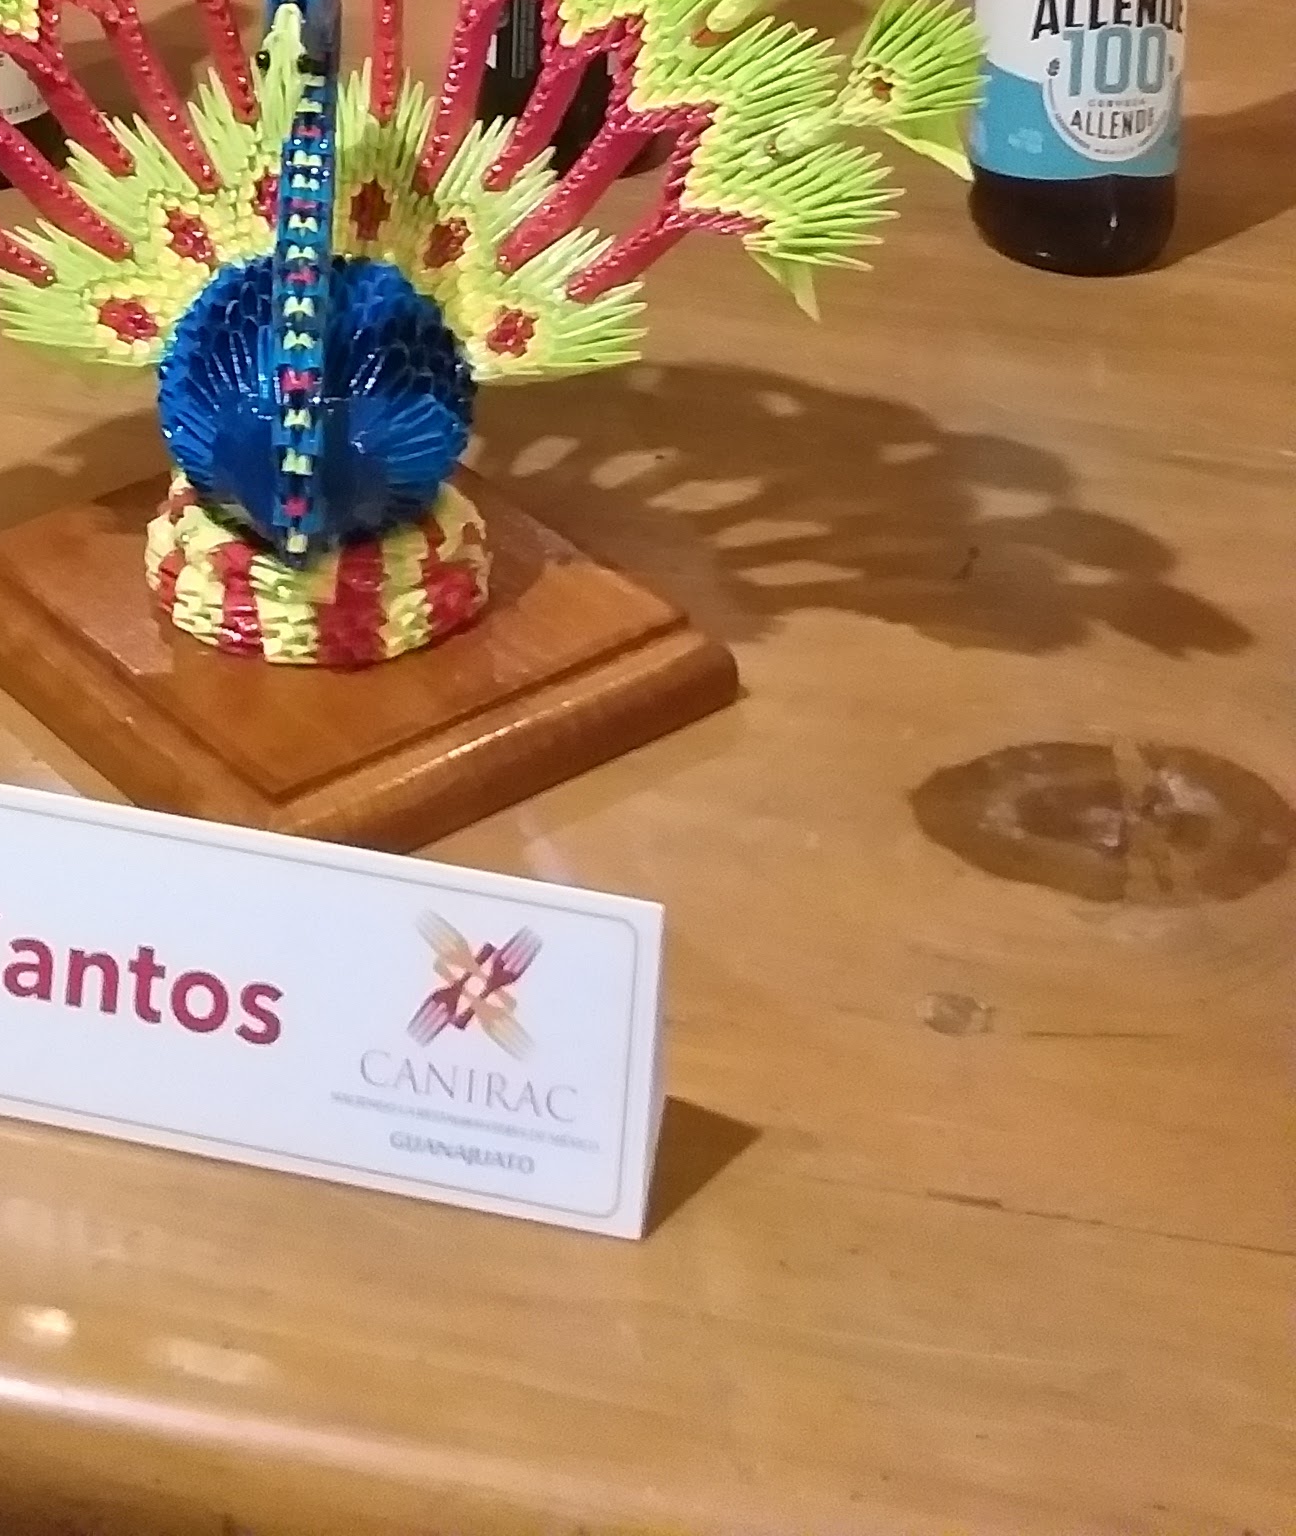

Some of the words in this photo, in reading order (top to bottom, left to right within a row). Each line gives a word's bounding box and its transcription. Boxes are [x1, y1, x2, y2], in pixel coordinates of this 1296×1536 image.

[1063, 26, 1166, 96] 100
[1070, 106, 1155, 139] ALLENDE
[360, 1049, 578, 1123] CANIRAC
[389, 1130, 536, 1175] GUANAJUATO
